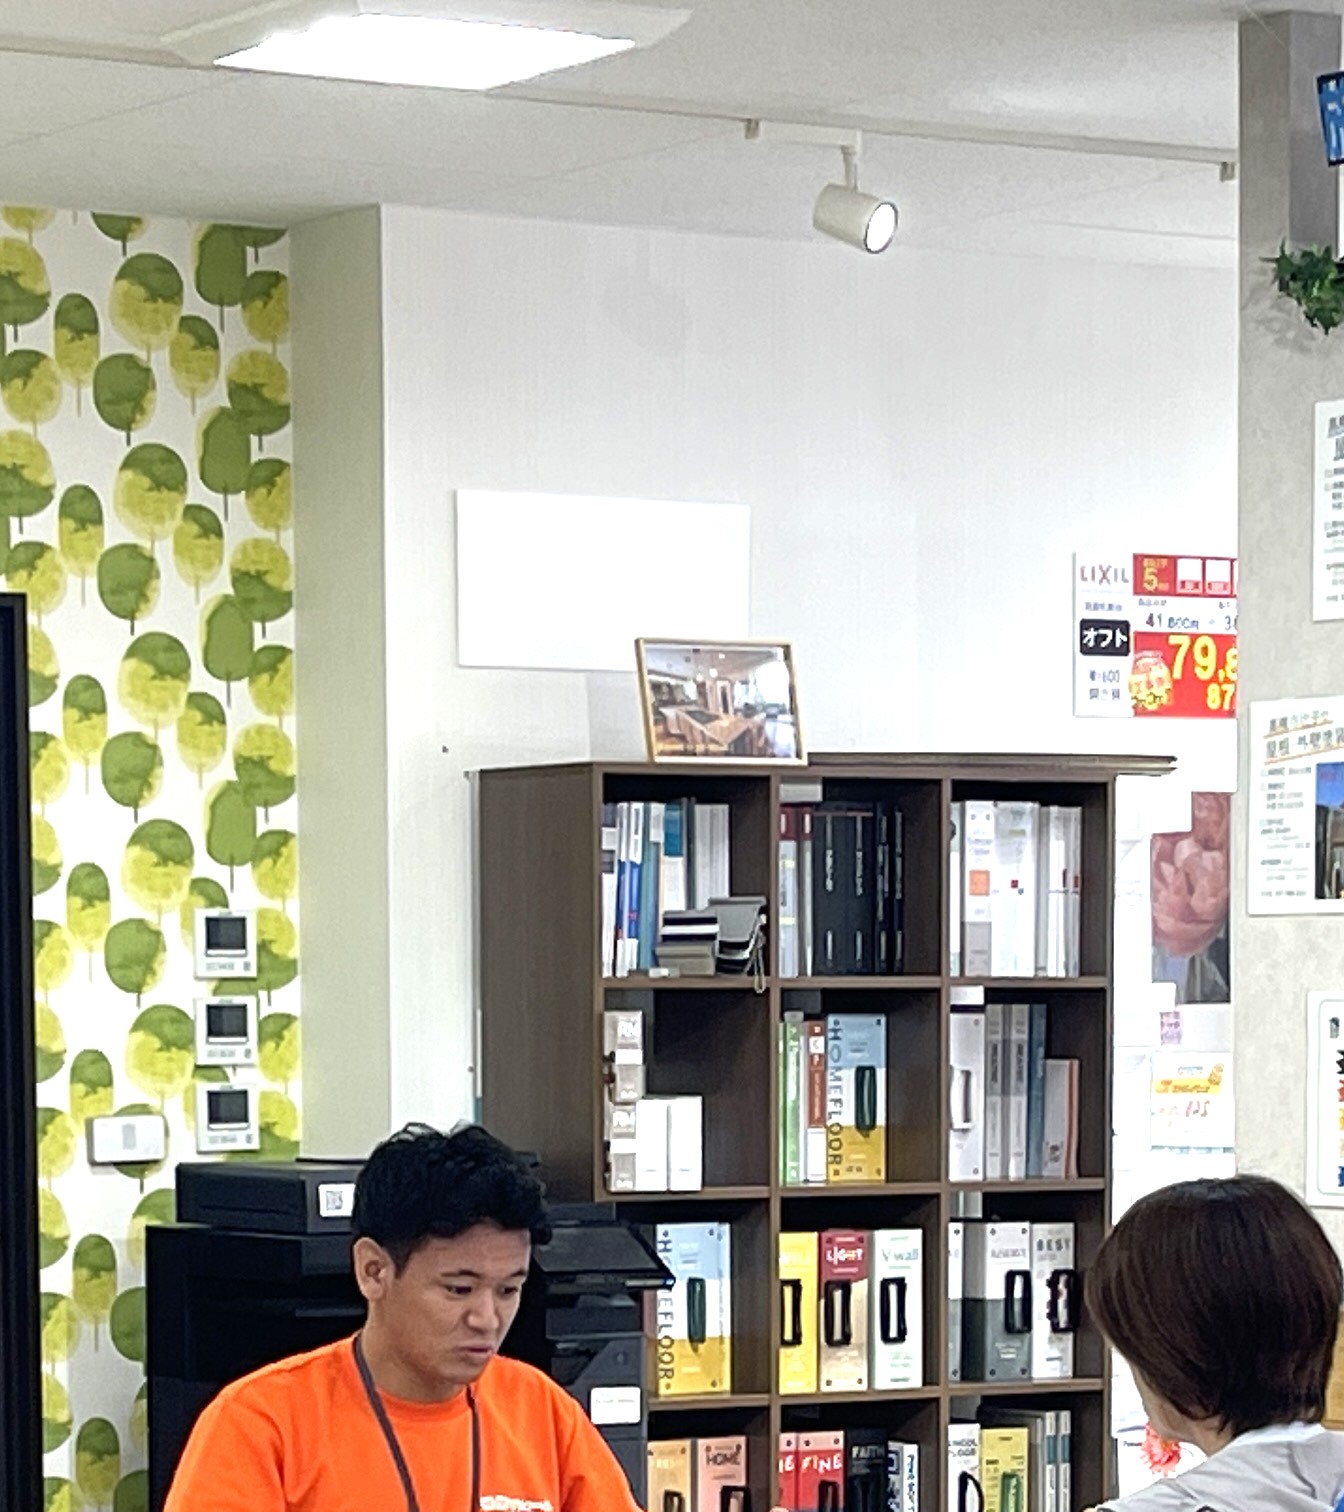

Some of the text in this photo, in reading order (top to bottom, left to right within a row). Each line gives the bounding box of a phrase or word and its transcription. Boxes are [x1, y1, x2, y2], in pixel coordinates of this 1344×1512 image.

[1080, 564, 1129, 585] LIXIL
[1083, 627, 1128, 648] オフト
[828, 1028, 844, 1165] HOMEFLOOR
[1036, 1238, 1070, 1251] BEST
[658, 1240, 675, 1380] HEFLOOR
[801, 1453, 843, 1474] FINE
